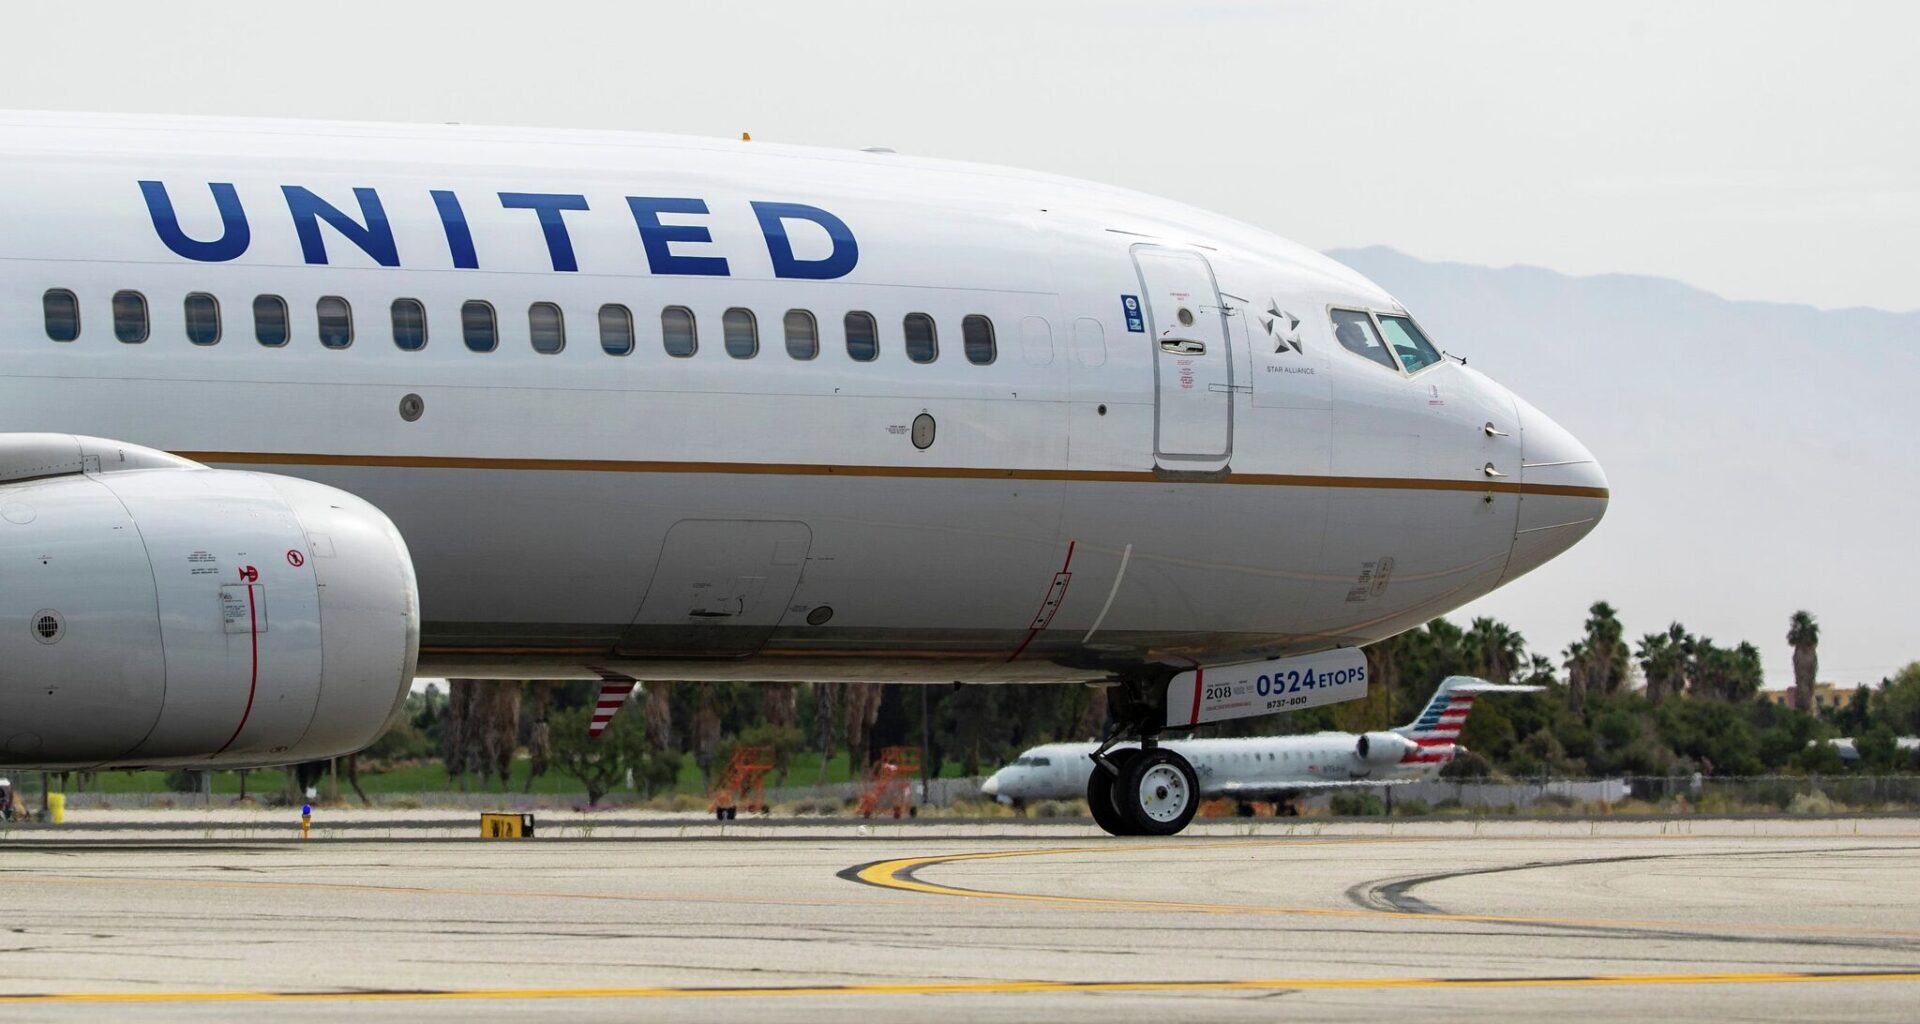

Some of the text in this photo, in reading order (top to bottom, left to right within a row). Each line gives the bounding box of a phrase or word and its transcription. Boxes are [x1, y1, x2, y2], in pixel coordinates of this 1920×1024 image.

[137, 180, 859, 280] UNITED
[1266, 365, 1316, 375] STAR ALLIANCE
[1256, 668, 1316, 697] 0524
[1319, 666, 1365, 688] ETOPS
[1206, 686, 1232, 700] 208
[1266, 696, 1307, 709] B737-800
